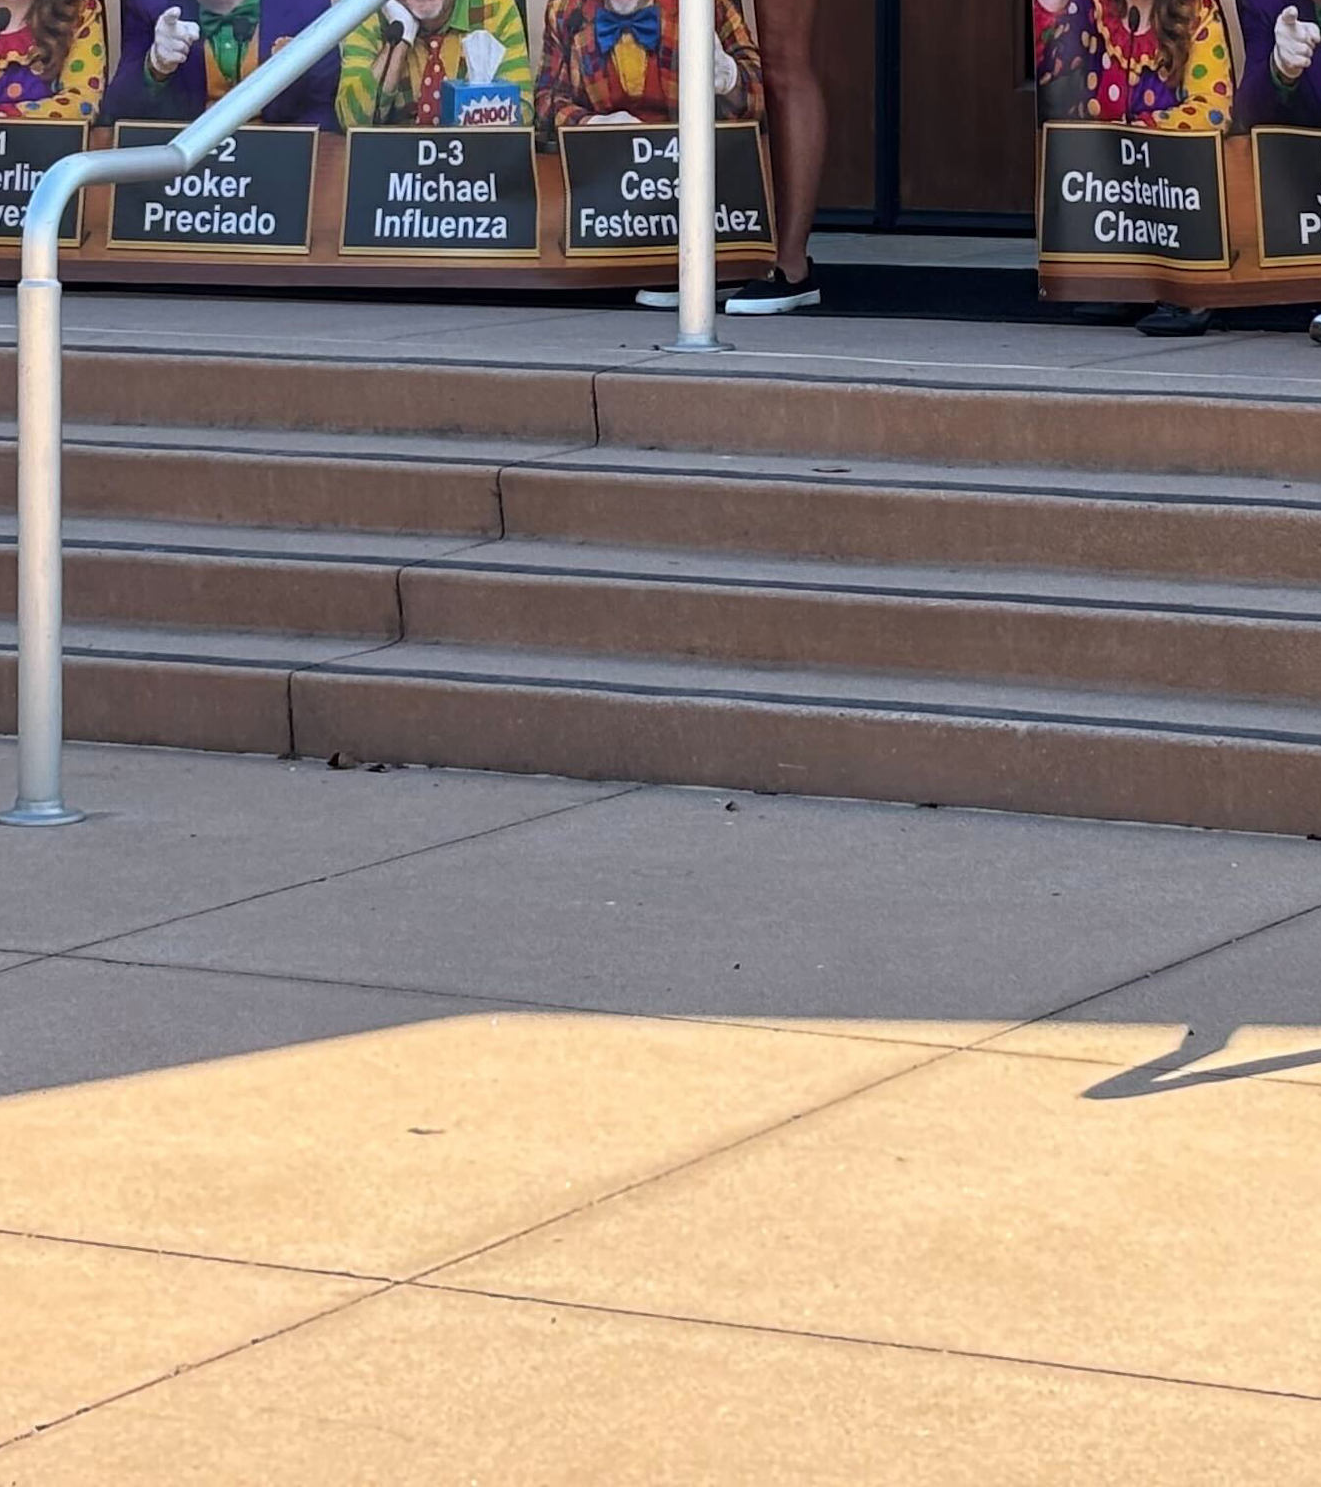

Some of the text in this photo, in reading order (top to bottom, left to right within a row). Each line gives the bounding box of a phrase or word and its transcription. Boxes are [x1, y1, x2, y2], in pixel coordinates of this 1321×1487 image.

[207, 136, 237, 162] -2
[417, 139, 465, 167] D-3
[632, 137, 678, 164] D-4
[1120, 138, 1151, 169] D-1
[164, 168, 253, 198] Joker
[387, 172, 497, 203] Michael
[1061, 170, 1201, 212] Chesterlina
[143, 201, 276, 235] Preciado
[374, 208, 507, 240] Influenza
[1093, 210, 1181, 249] Chavez
